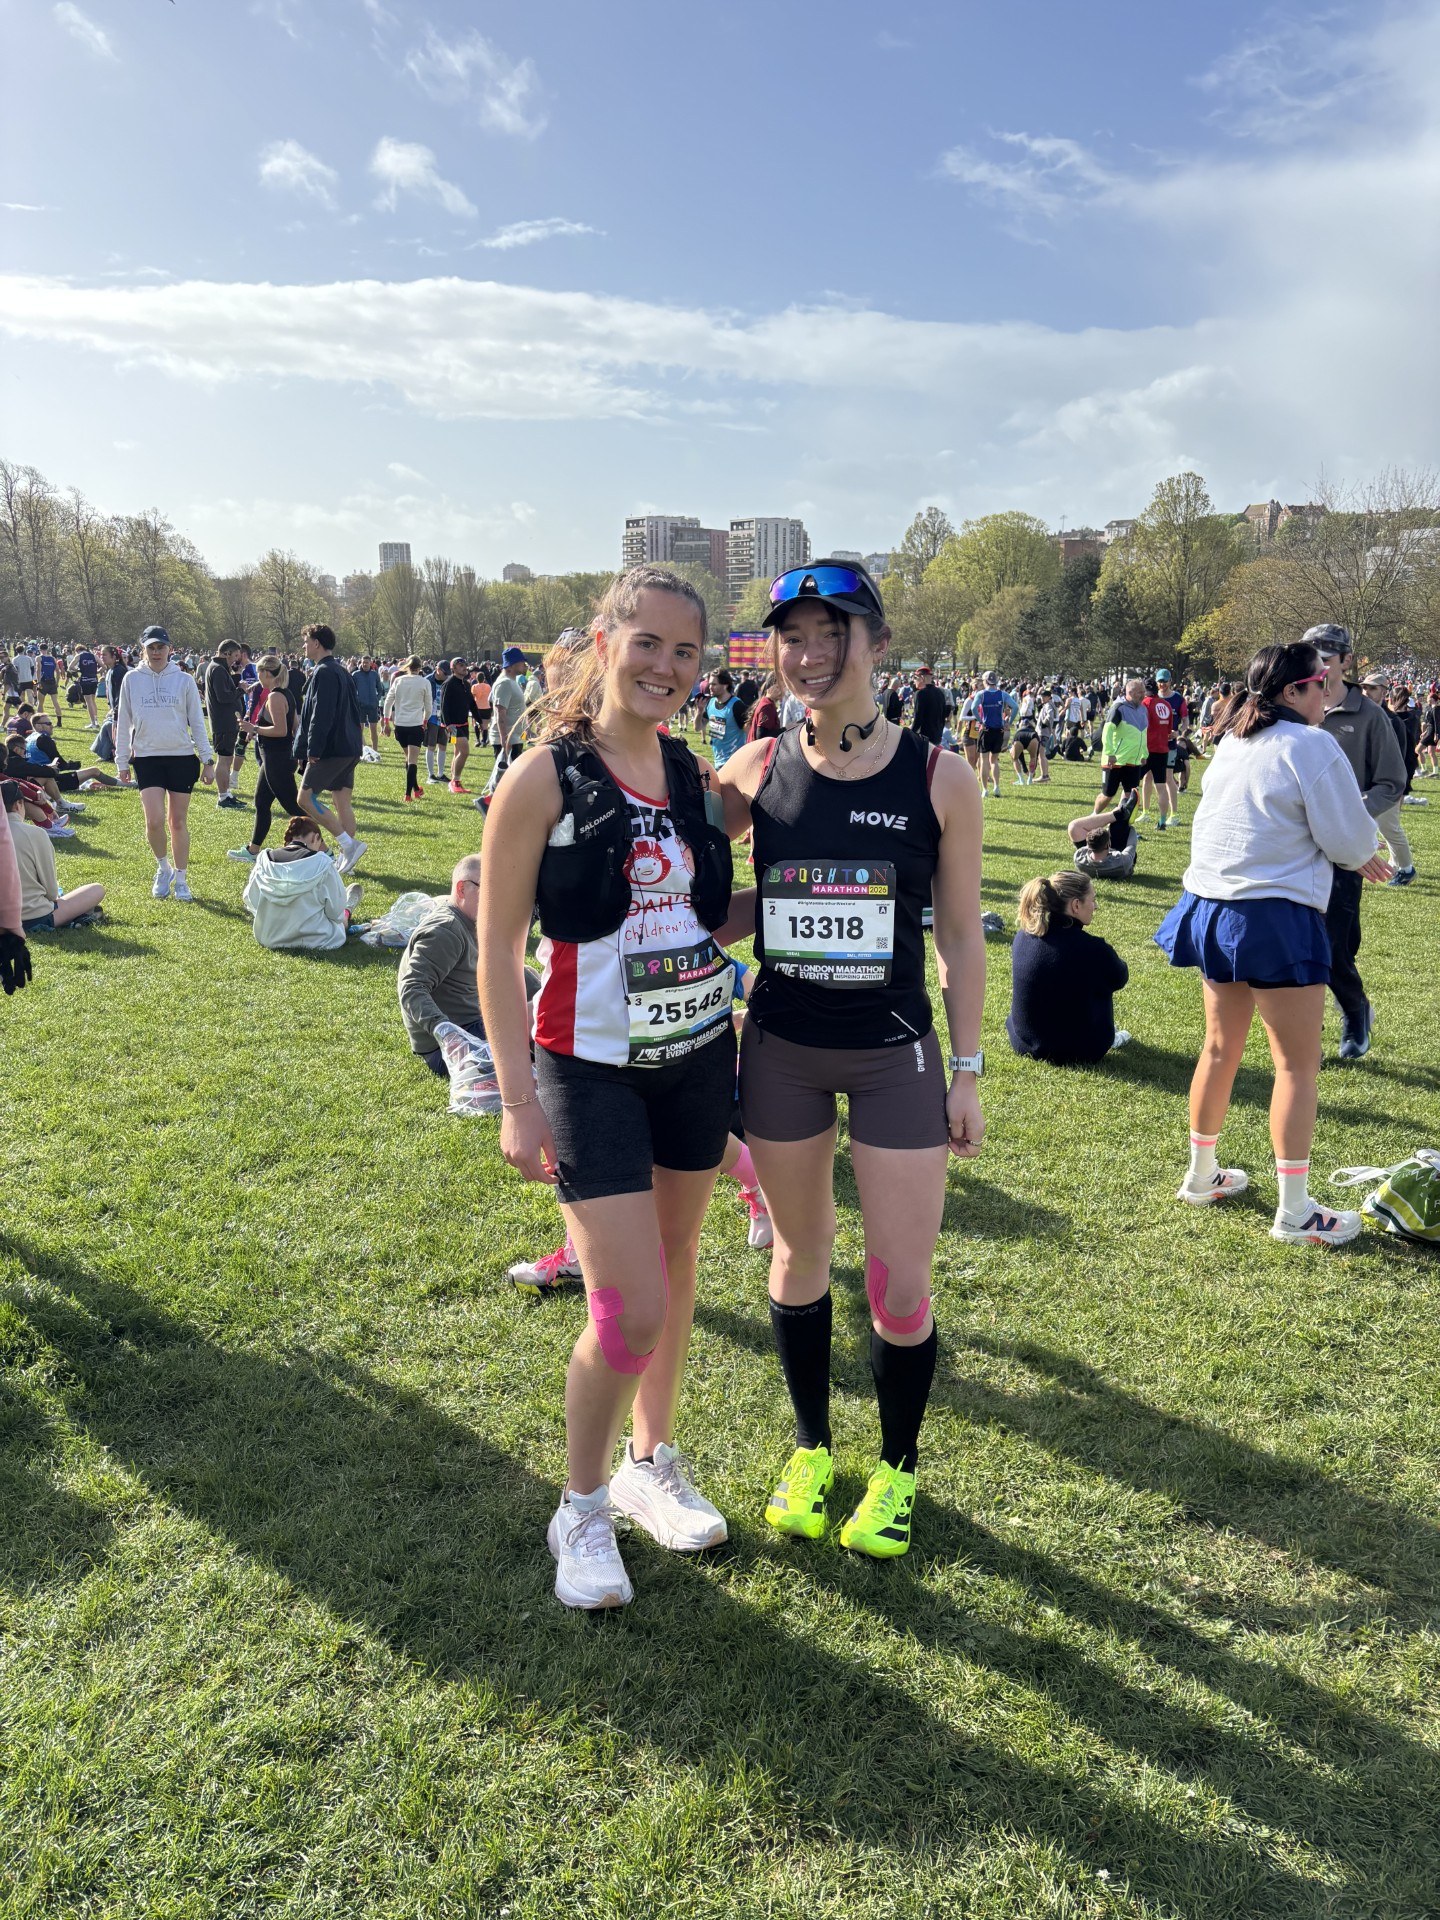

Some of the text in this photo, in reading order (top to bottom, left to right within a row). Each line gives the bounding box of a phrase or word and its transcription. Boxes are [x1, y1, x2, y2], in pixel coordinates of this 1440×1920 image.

[579, 808, 616, 834] SALOMON
[850, 810, 909, 831] MOVE
[769, 867, 887, 884] BRIGHTON
[812, 885, 868, 893] MARATHON
[626, 894, 693, 919] OAH'S
[769, 905, 776, 915] 2
[788, 915, 864, 940] 13318
[631, 946, 714, 977] BRIGHT
[799, 964, 886, 974] LONDON MARATHON
[799, 972, 829, 980] EVENTS
[635, 997, 642, 1006] 3
[648, 986, 723, 1025] 25548
[665, 1038, 697, 1053] LONDON
[696, 1020, 729, 1042] MARATHON
[665, 1046, 692, 1059] EVENTS
